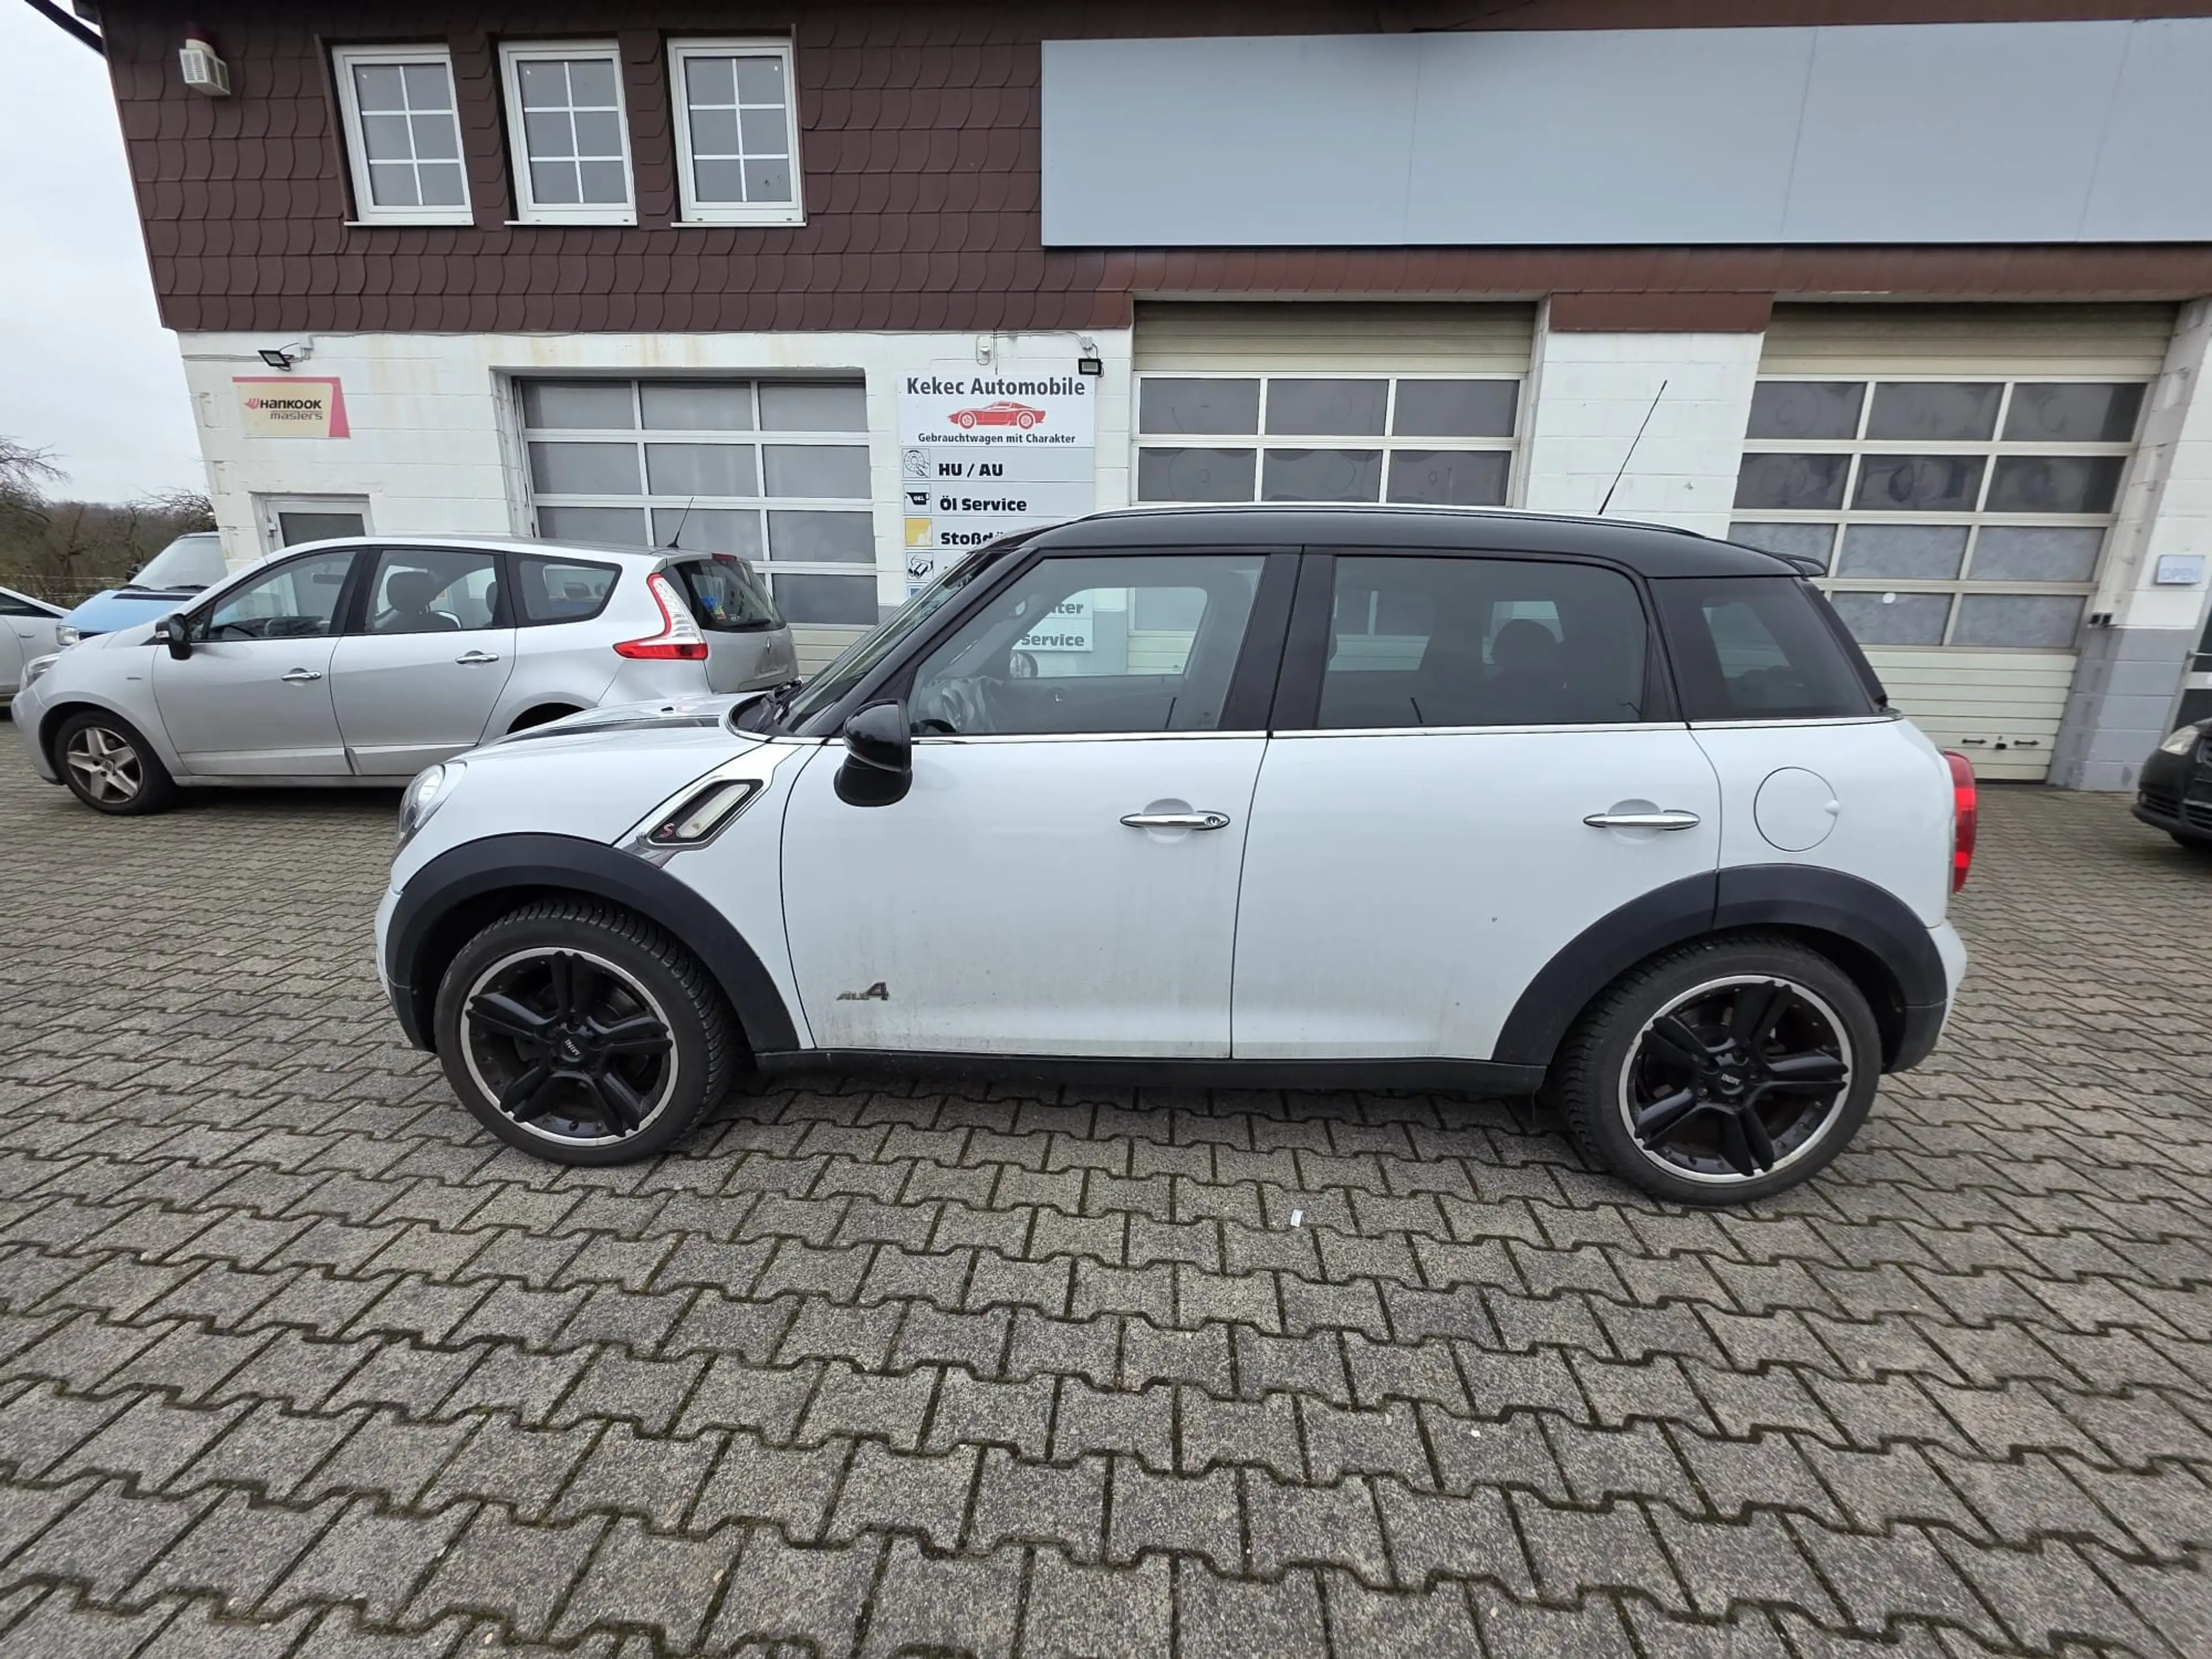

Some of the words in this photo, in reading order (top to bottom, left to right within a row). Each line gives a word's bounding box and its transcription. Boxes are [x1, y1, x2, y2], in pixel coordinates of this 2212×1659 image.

[907, 377, 965, 395] Kekec
[971, 377, 1085, 396] Automobile
[918, 433, 1003, 445] Gebrauchtwagen
[1006, 433, 1023, 444] mit
[1026, 434, 1075, 444] Charakter
[938, 463, 962, 477] HU
[967, 463, 975, 479] /
[979, 464, 1003, 477] AU
[940, 495, 957, 511] Öl
[962, 498, 1027, 512] Service
